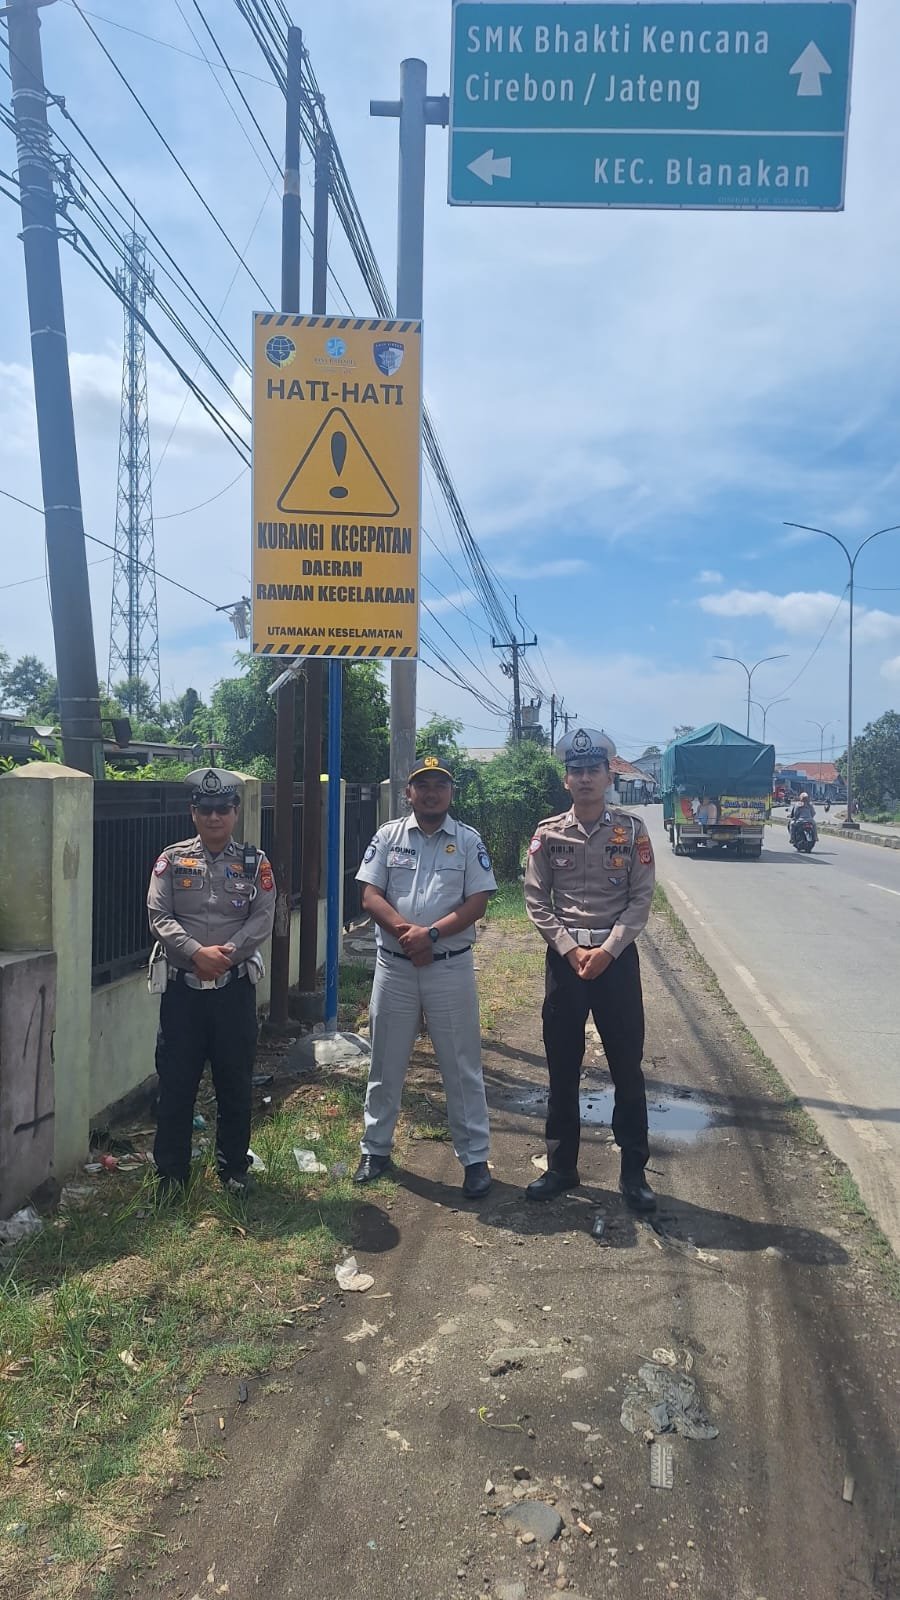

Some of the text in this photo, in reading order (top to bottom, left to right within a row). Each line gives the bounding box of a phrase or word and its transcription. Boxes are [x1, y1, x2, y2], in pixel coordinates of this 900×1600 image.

[467, 24, 769, 54] SMK Bhakti Kencana
[466, 73, 700, 110] Cirebon / Jateng
[594, 158, 810, 187] KEC. Blanakan
[267, 379, 404, 405] HATI-HATI
[257, 522, 412, 554] KURANGI KECEPATAN
[302, 559, 362, 577] DAERAH
[256, 584, 415, 604] RAWAN KECELAKAAN
[267, 626, 403, 639] UTAMAKAN KESELAMATAN
[390, 846, 416, 856] AGUNG
[605, 845, 631, 855] POLRI
